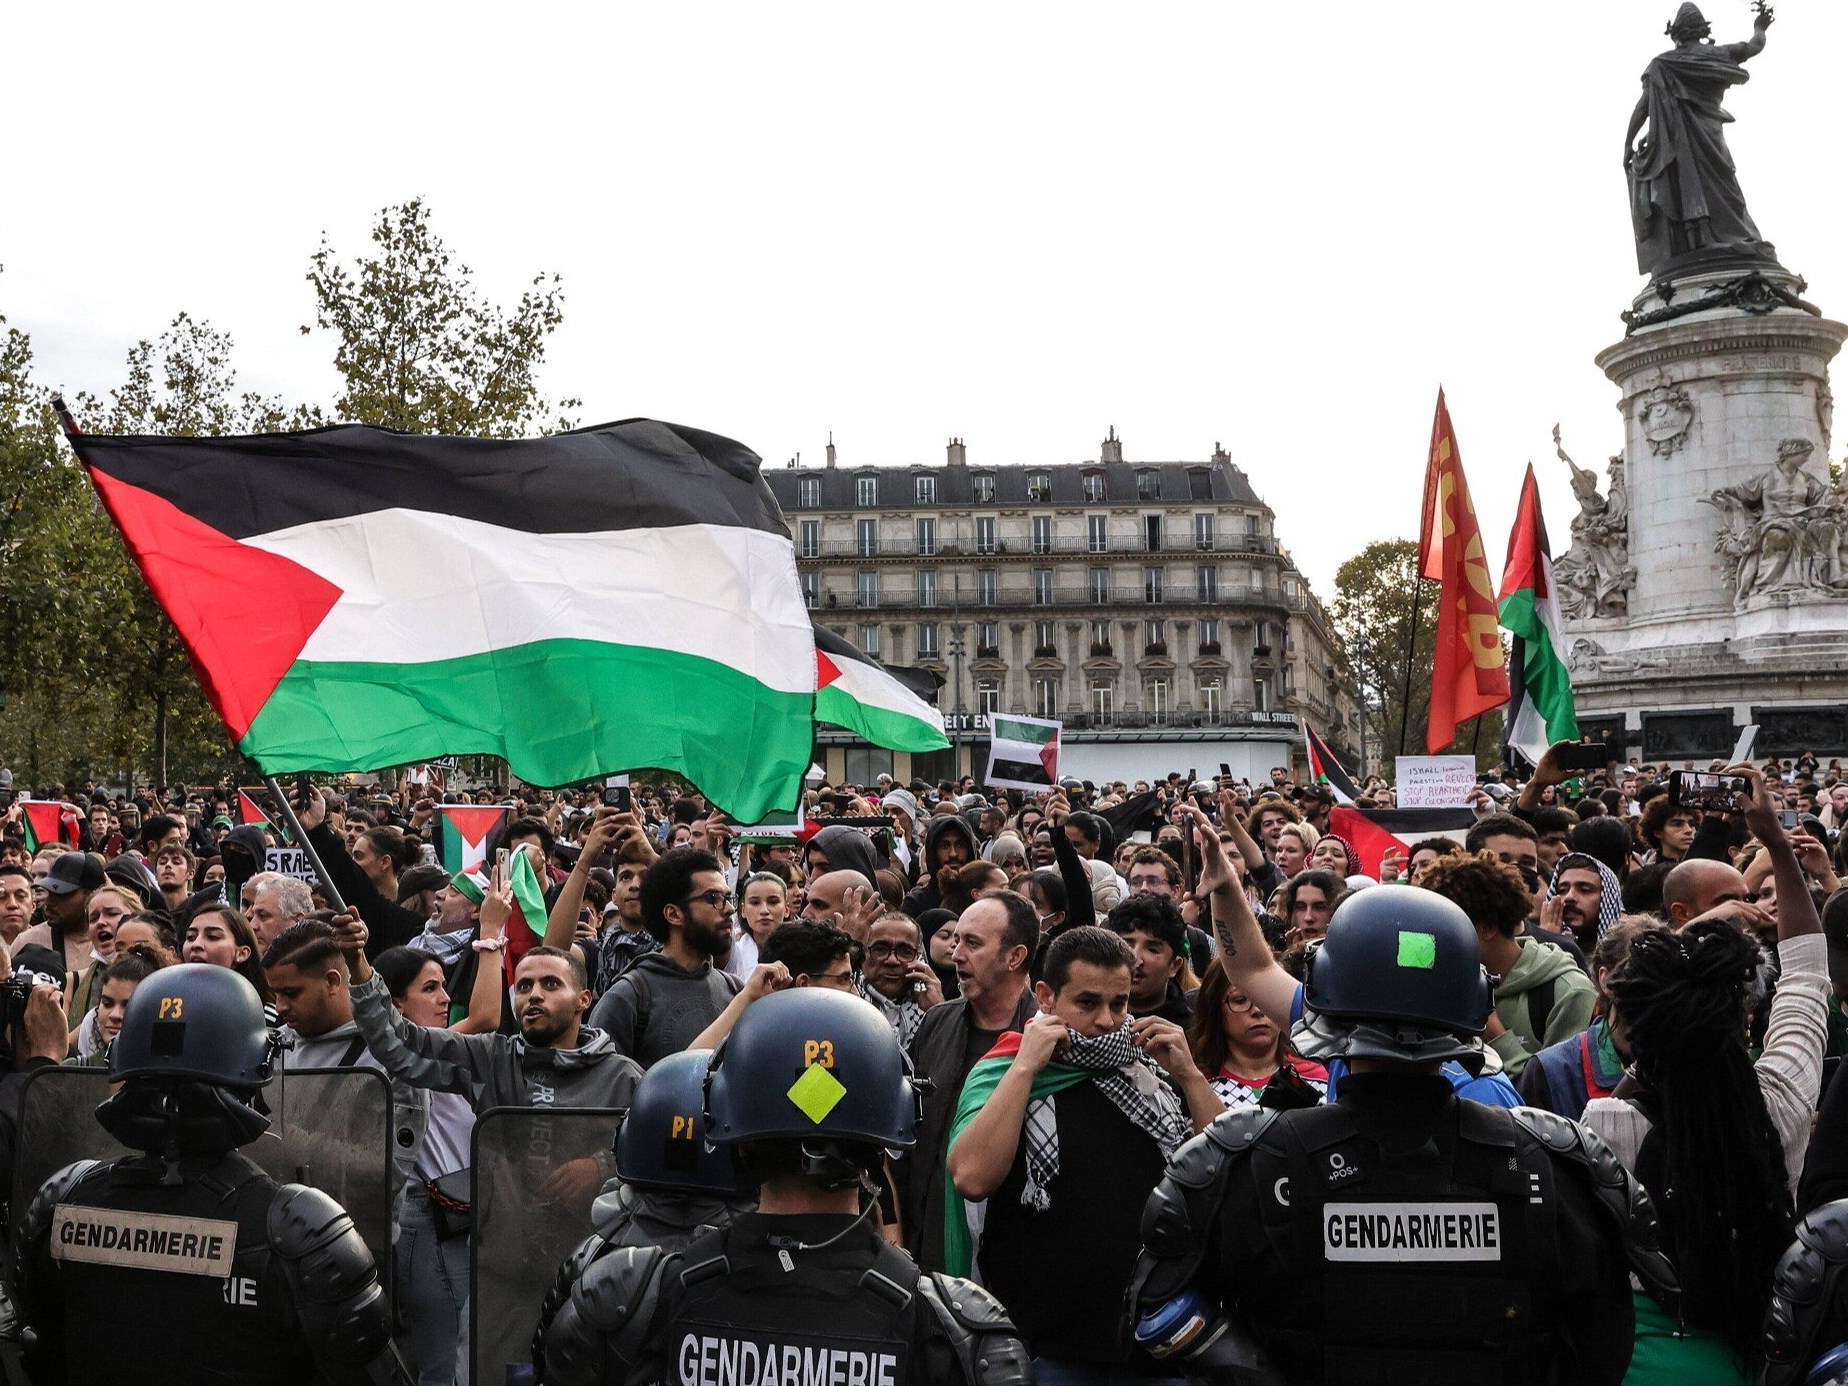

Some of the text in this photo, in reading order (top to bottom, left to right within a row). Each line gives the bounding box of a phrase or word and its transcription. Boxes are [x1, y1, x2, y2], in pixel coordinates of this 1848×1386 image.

[1251, 711, 1295, 723] WALL STREET
[267, 853, 312, 873] SRAE
[159, 997, 183, 1019] P3
[804, 1040, 834, 1068] P3
[672, 1115, 694, 1140] P1
[60, 1221, 223, 1260] GENDARMERIE
[1327, 1214, 1497, 1249] GENDARMERIE
[679, 1333, 897, 1386] GENDARMERIE
